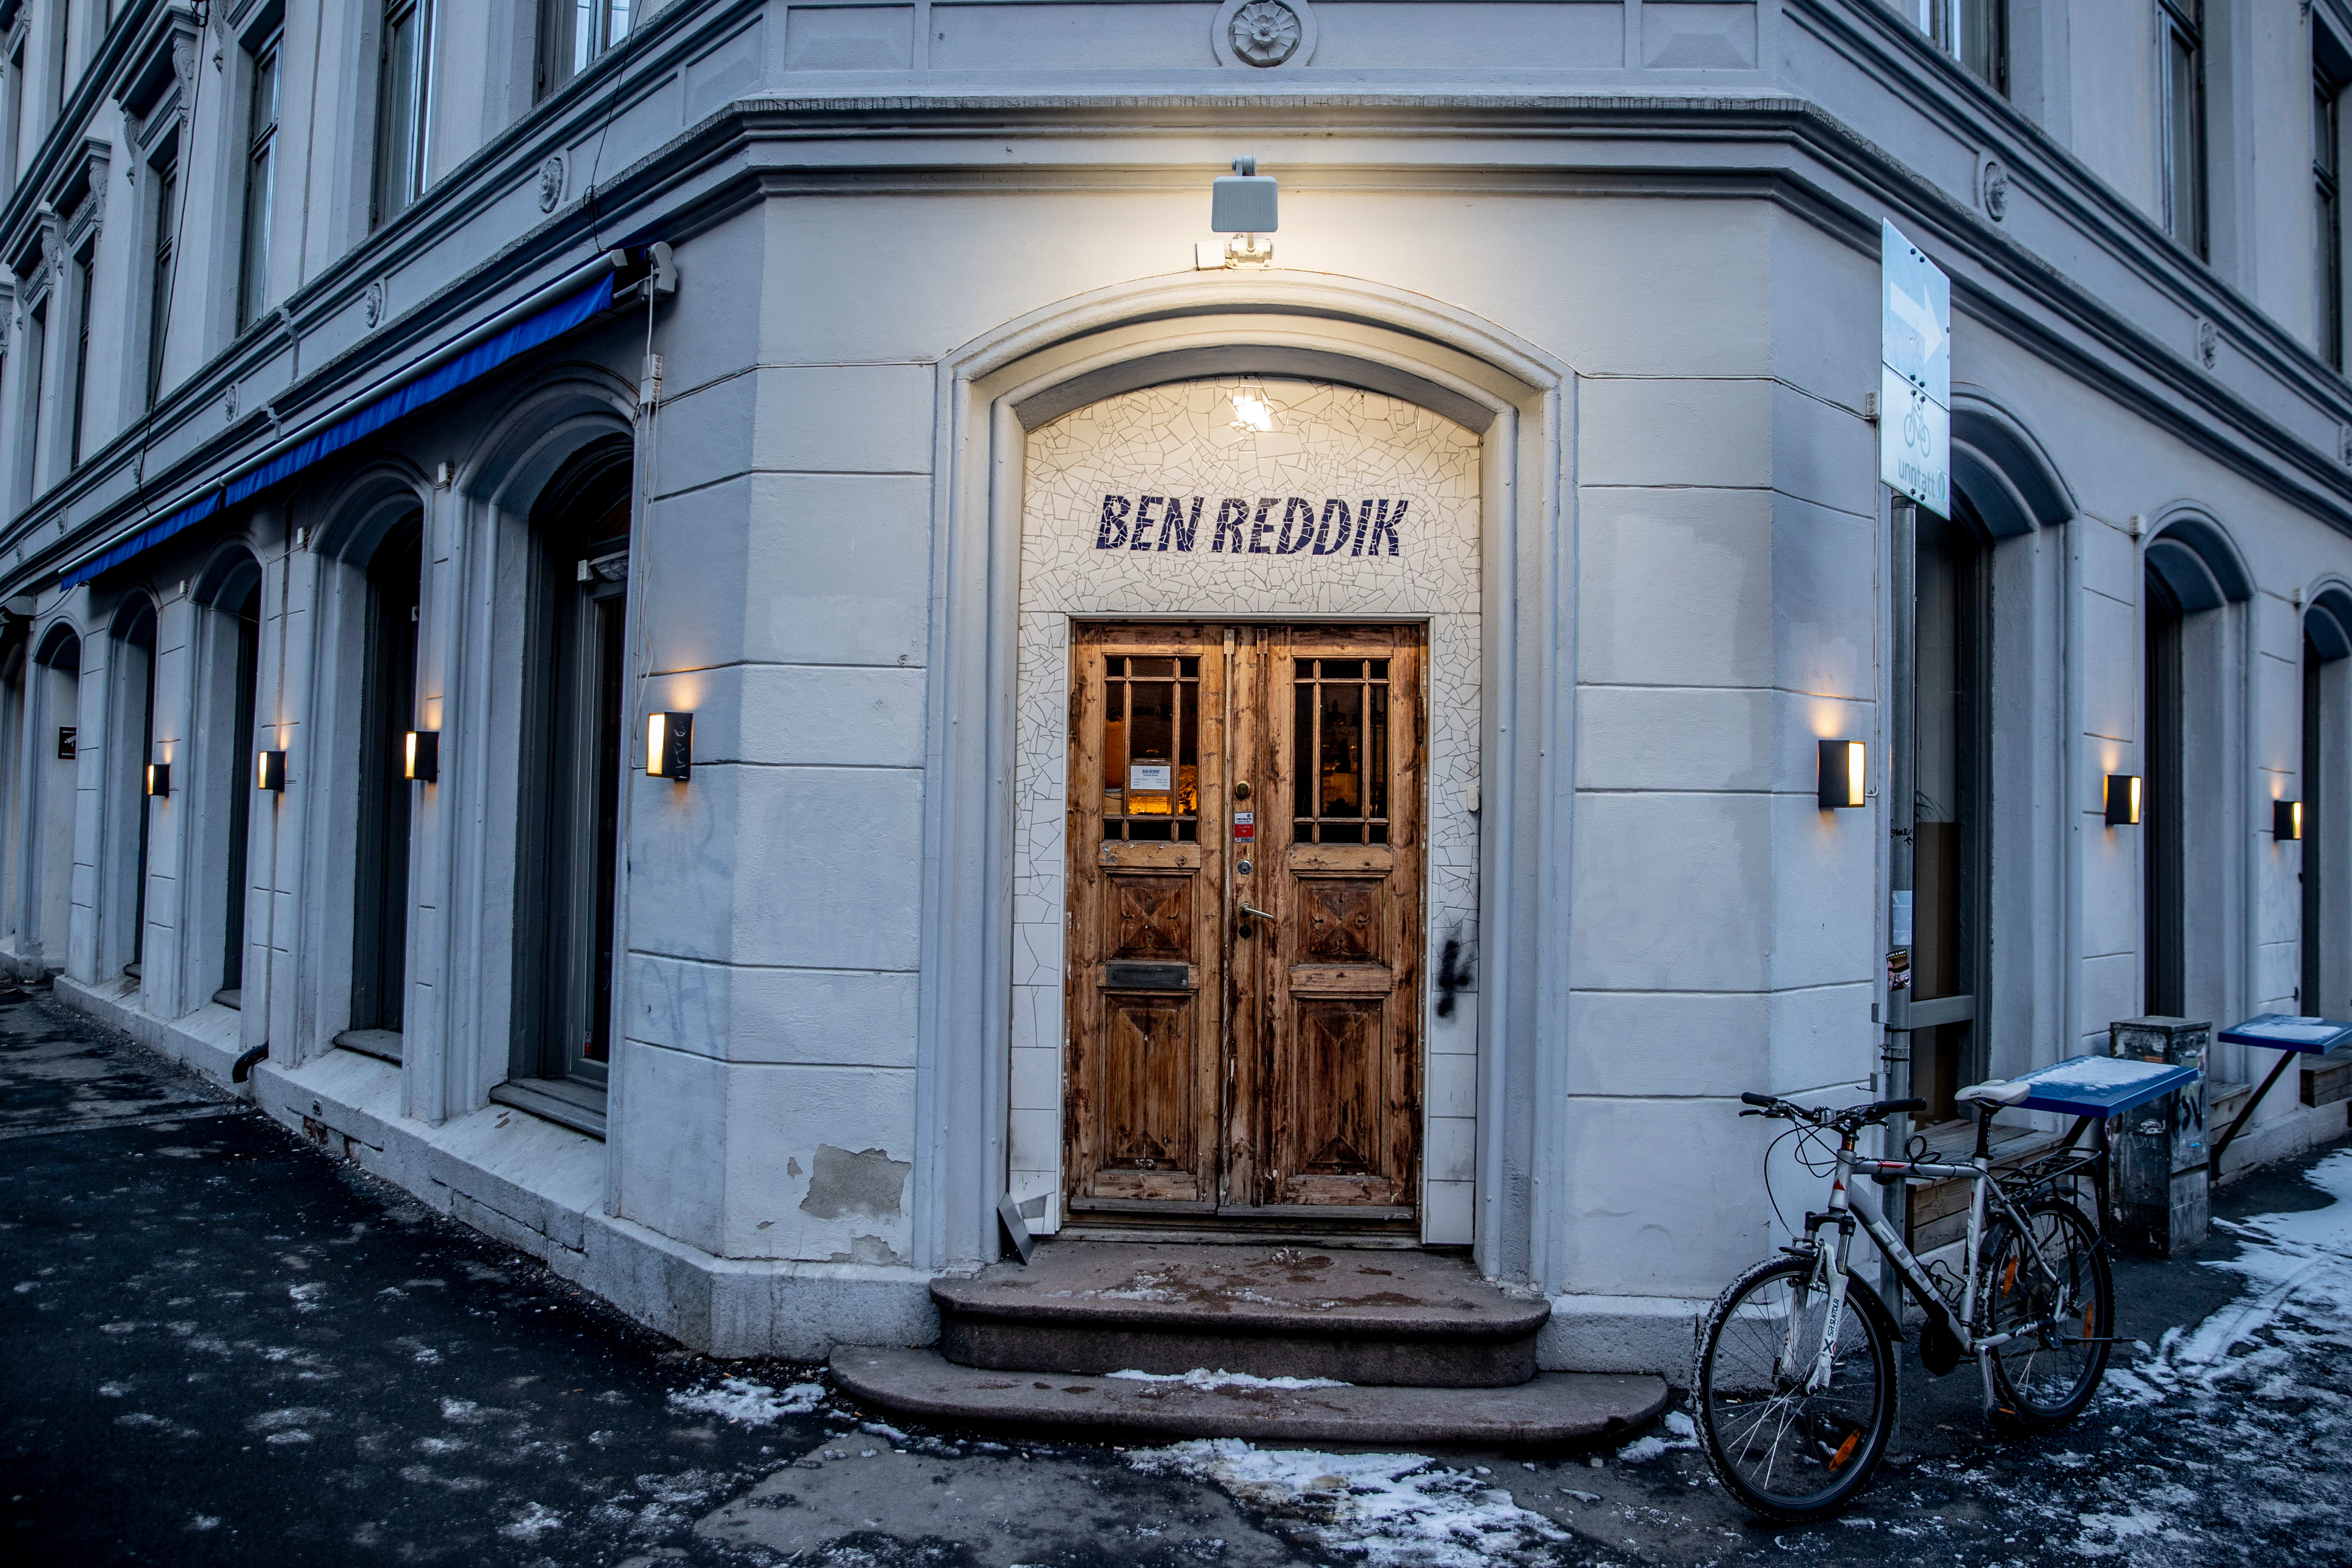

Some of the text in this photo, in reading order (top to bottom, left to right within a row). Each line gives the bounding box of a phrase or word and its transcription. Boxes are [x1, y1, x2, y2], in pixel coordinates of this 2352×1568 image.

[1898, 458, 1935, 498] unntatt
[1095, 494, 1409, 556] BEN REDDIK
[1866, 1220, 1939, 1301] FUJI
[1829, 1298, 1839, 1325] SUNTOUR
